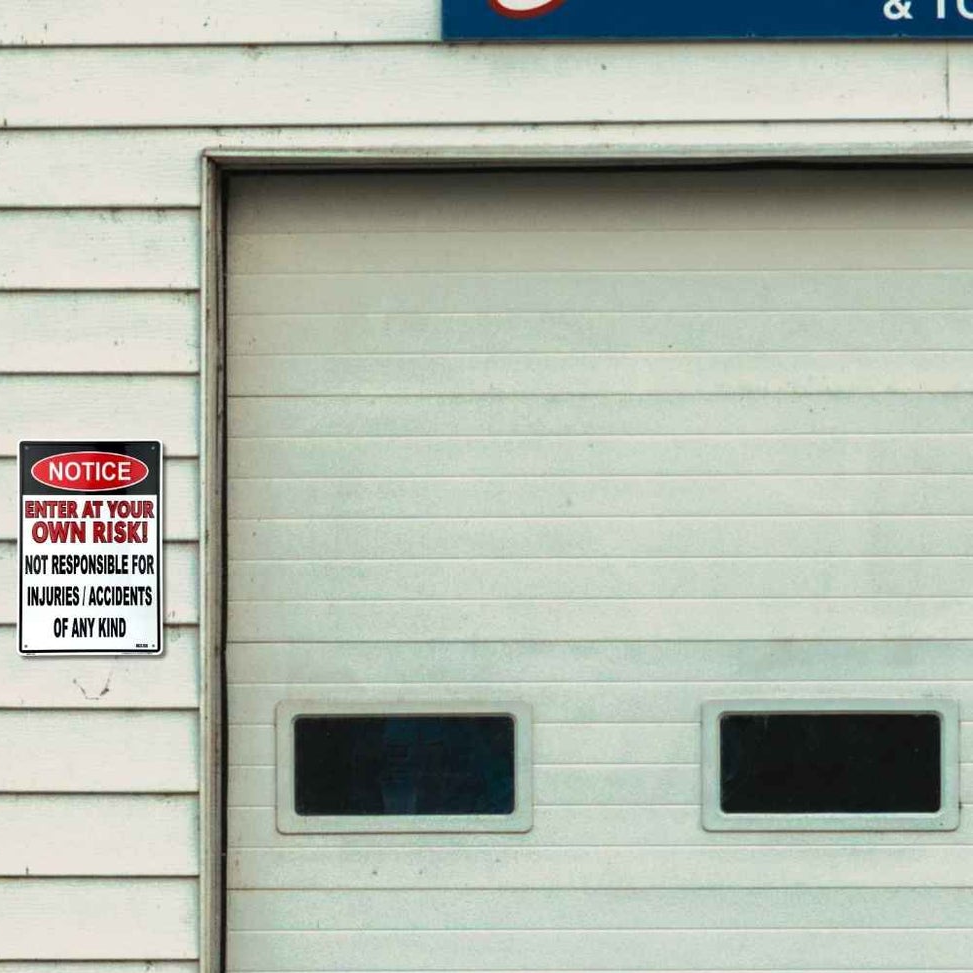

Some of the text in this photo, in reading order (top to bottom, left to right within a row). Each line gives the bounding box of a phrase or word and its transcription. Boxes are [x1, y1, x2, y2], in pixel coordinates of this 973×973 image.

[49, 462, 131, 481] NOTICE
[25, 501, 155, 518] ENTER AT YOUR
[32, 521, 148, 543] OWN RISK!
[25, 555, 154, 574] NOT RESPONSIBLE FOR
[28, 587, 79, 606] INJURIES
[89, 587, 152, 606] ACCIDENTS
[54, 618, 126, 638] OF ANY KIND
